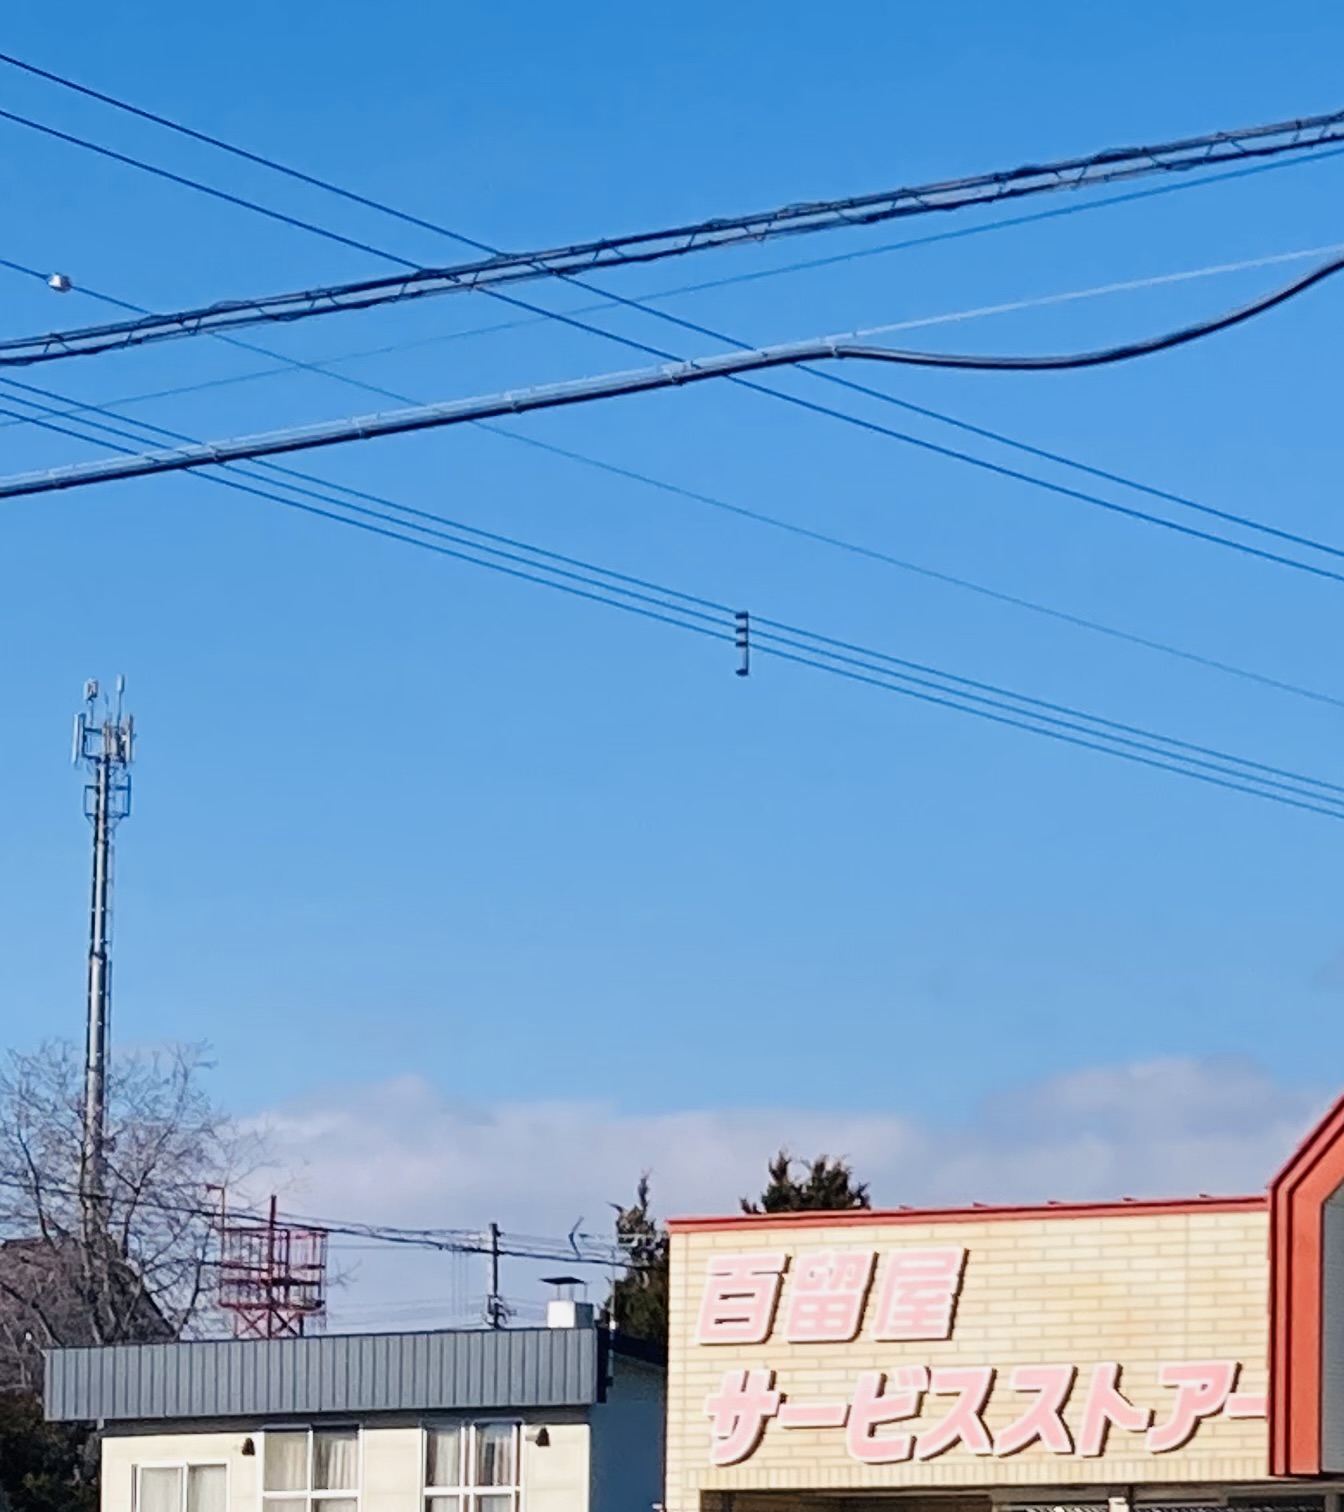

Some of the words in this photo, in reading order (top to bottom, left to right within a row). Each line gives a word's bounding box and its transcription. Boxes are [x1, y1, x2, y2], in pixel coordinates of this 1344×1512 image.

[699, 1247, 967, 1344] 百留屋
[703, 1362, 1268, 1466] サービスストアー
